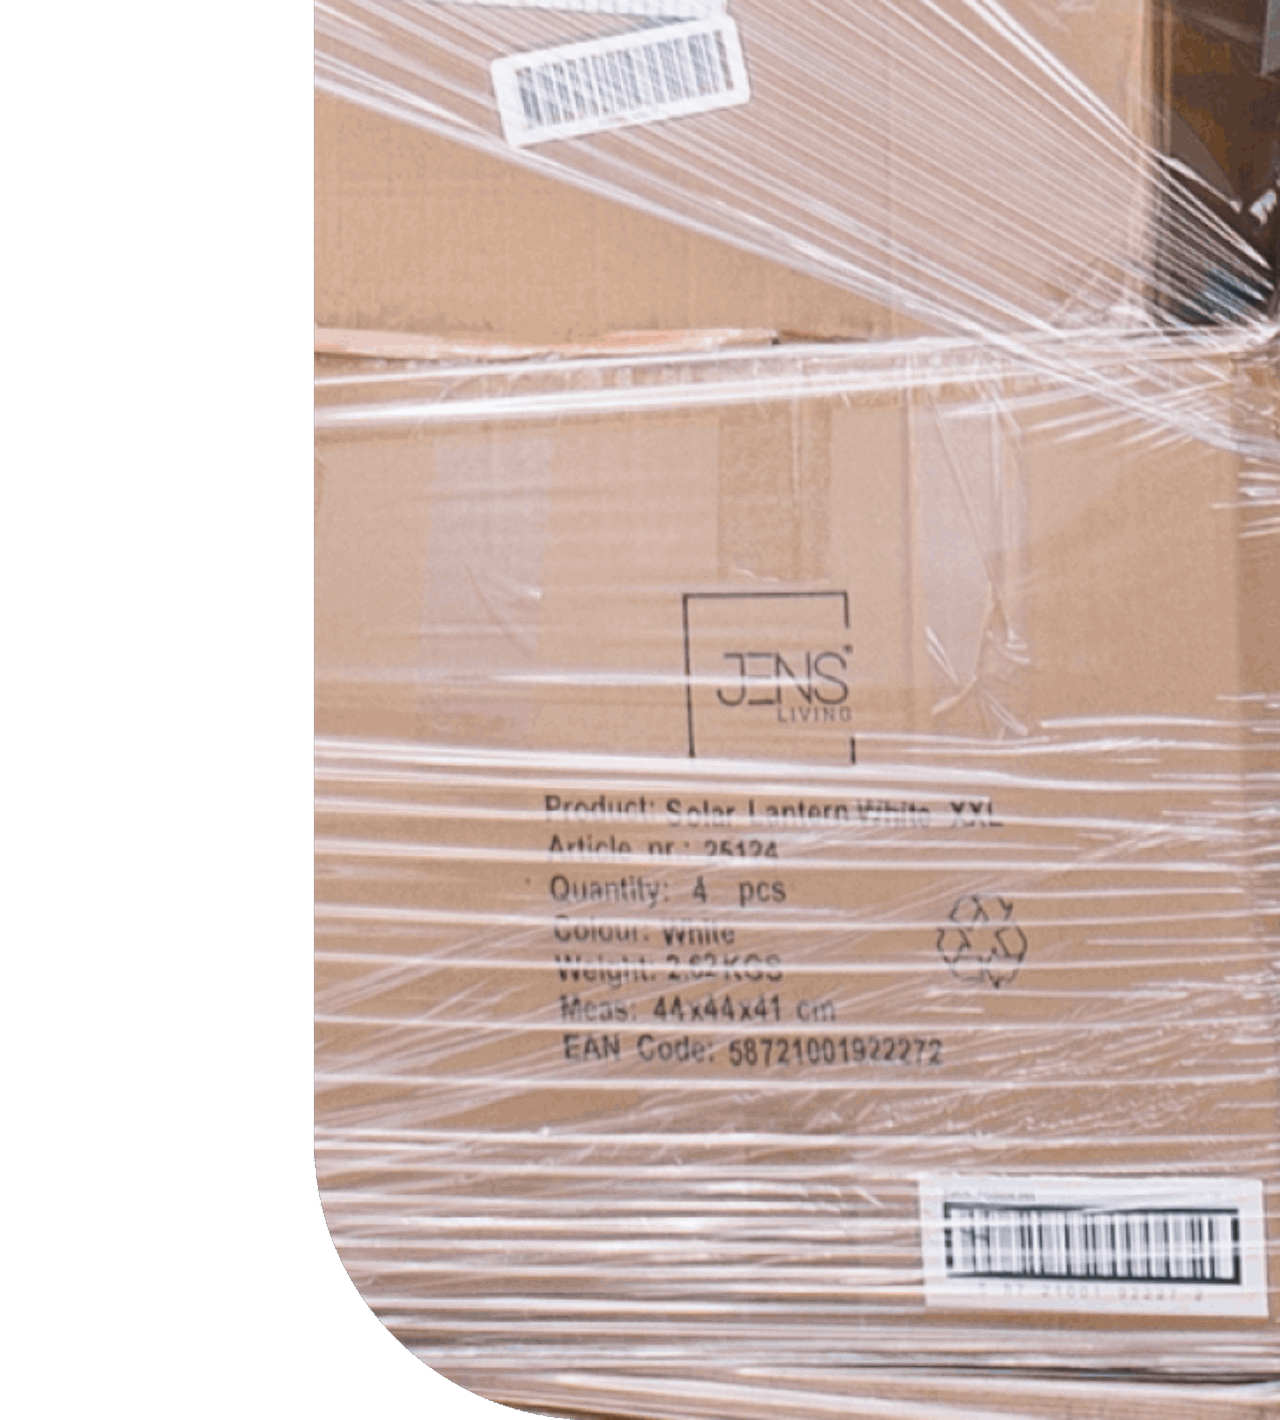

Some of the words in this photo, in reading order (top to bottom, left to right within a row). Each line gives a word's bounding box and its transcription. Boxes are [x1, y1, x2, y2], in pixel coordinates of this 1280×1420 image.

[717, 651, 848, 707] JENS
[778, 706, 852, 723] LIVING
[666, 798, 735, 827] Solar
[950, 800, 1004, 827] XXL
[549, 833, 633, 860] Article
[550, 874, 669, 909] Quantity:
[693, 874, 708, 903] 4
[739, 879, 786, 908] pcs
[558, 992, 638, 1022] Meas:
[652, 993, 780, 1022] 44x44x41
[796, 999, 836, 1023] cm
[563, 1033, 621, 1061] EAN
[636, 1033, 714, 1063] Code:
[729, 1035, 943, 1067] 58721001922272
